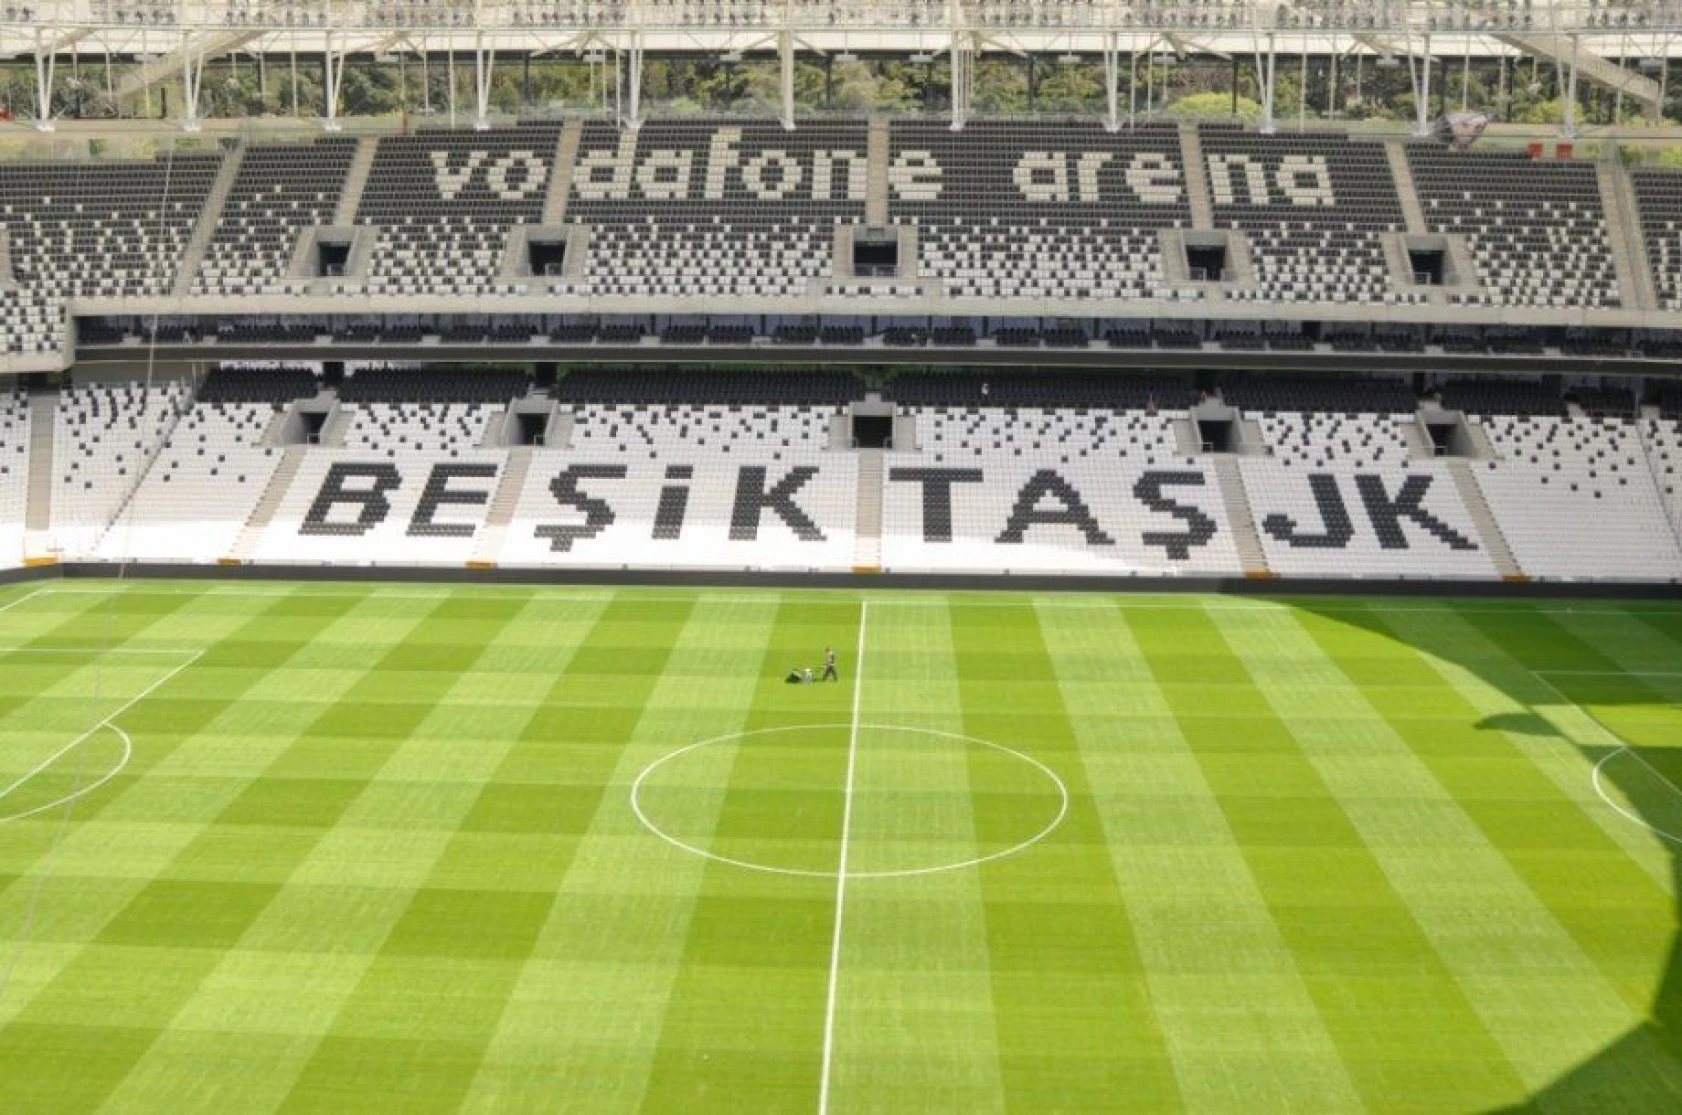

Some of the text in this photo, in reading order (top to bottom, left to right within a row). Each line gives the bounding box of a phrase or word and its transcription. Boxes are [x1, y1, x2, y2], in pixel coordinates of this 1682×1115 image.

[431, 126, 1335, 206] vodafone arena
[1262, 474, 1479, 549] JK
